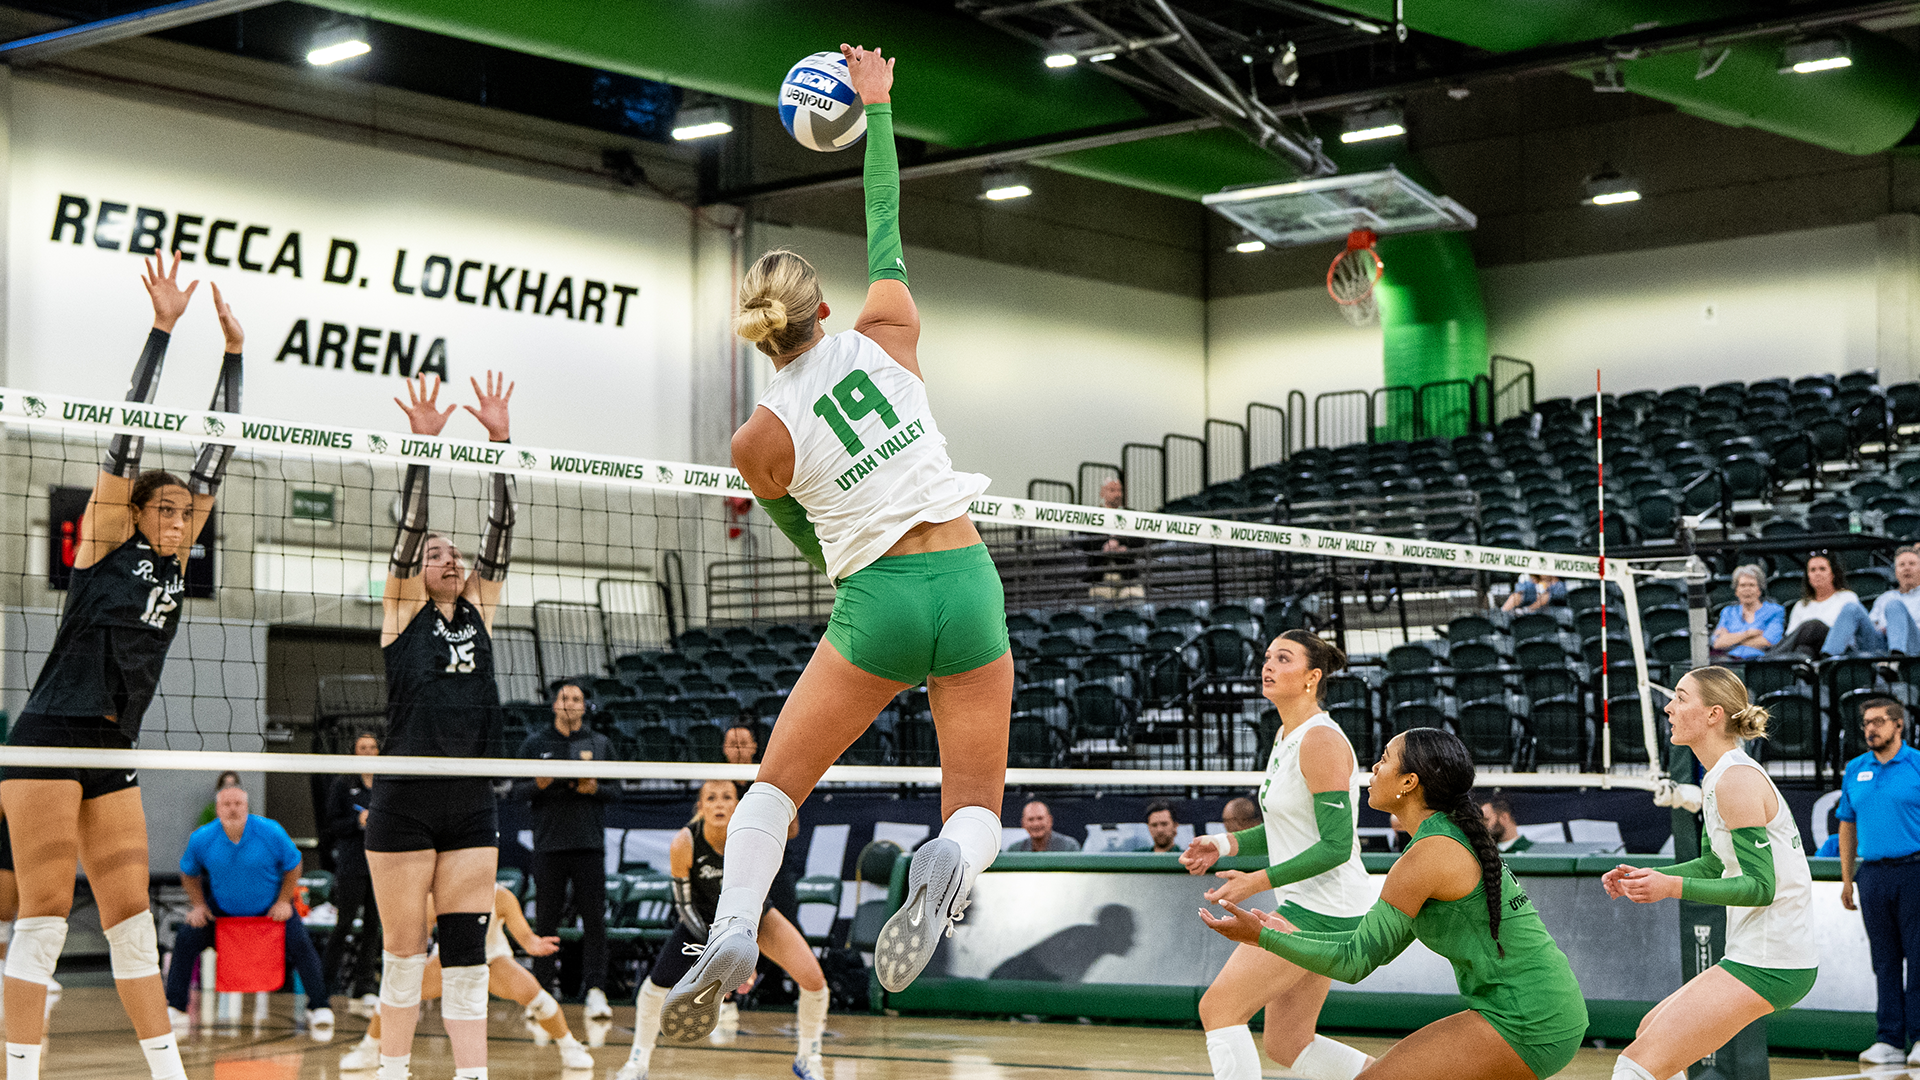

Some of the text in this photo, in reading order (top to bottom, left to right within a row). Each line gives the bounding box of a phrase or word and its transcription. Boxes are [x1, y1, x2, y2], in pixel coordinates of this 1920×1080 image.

[786, 87, 833, 111] molten
[792, 70, 839, 94] NCAA
[50, 193, 639, 327] REBECCA D. LOCKHART
[274, 318, 449, 383] ARENA
[62, 401, 752, 491] UTAH VALLEY WOLVERINES UTAH VALLEY WOLVERINES UTAH VAL
[812, 368, 901, 458] 19
[833, 417, 926, 492] UTAH VALLEY
[966, 500, 1003, 517] ALLEY
[1034, 506, 1105, 527] WOLVERINES
[1135, 517, 1162, 533] UTAH
[1165, 520, 1203, 536] VALLEY
[1230, 526, 1293, 546] WOLVERINES
[1318, 536, 1342, 550] UTAH
[1345, 538, 1378, 553] VALLEY
[1402, 544, 1457, 561] WOLVERINES
[1479, 551, 1501, 564] UTAH
[1504, 553, 1533, 568] VALLEY
[140, 585, 178, 630] 12
[445, 640, 477, 674] 15
